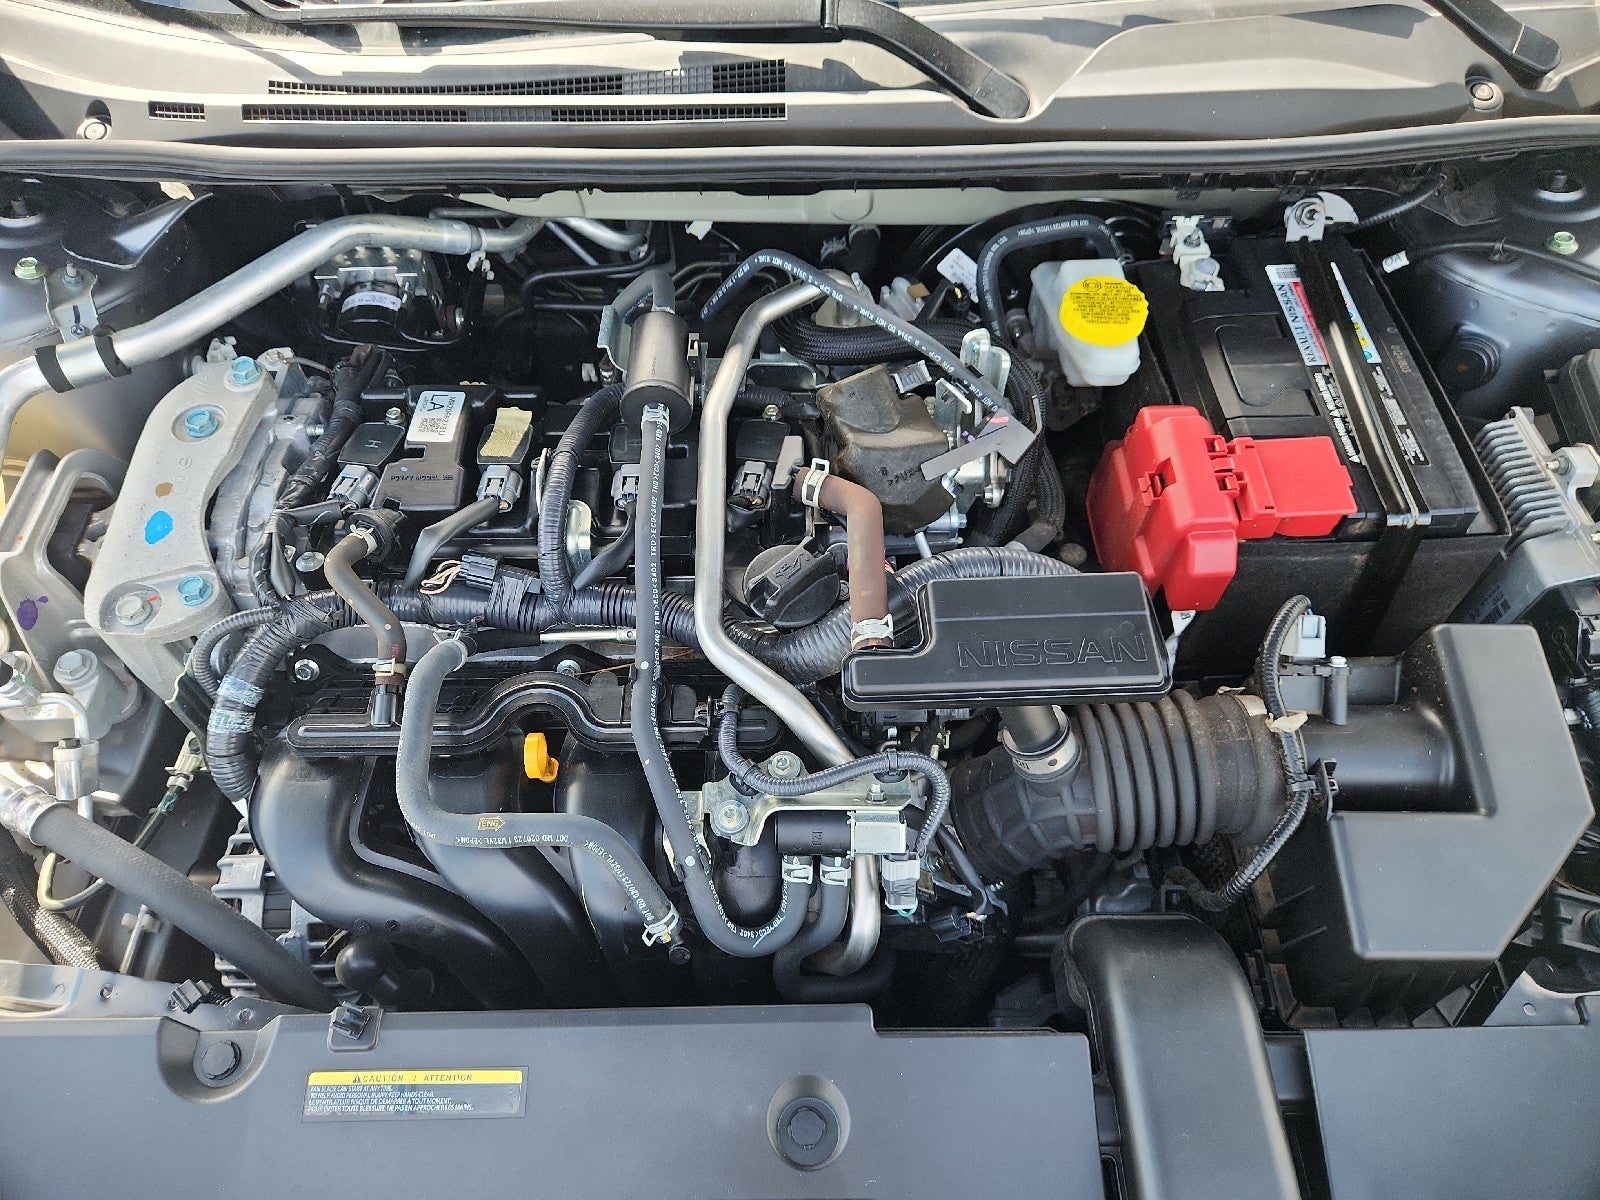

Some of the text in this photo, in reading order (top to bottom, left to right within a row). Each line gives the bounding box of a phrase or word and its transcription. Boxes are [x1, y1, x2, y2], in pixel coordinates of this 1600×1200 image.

[1276, 284, 1300, 323] NISSAN
[427, 394, 449, 412] LA
[957, 633, 1148, 668] NISSAN
[480, 819, 499, 827] ENG
[362, 1074, 404, 1083] CAUTION
[423, 1074, 473, 1082] ATTENTION
